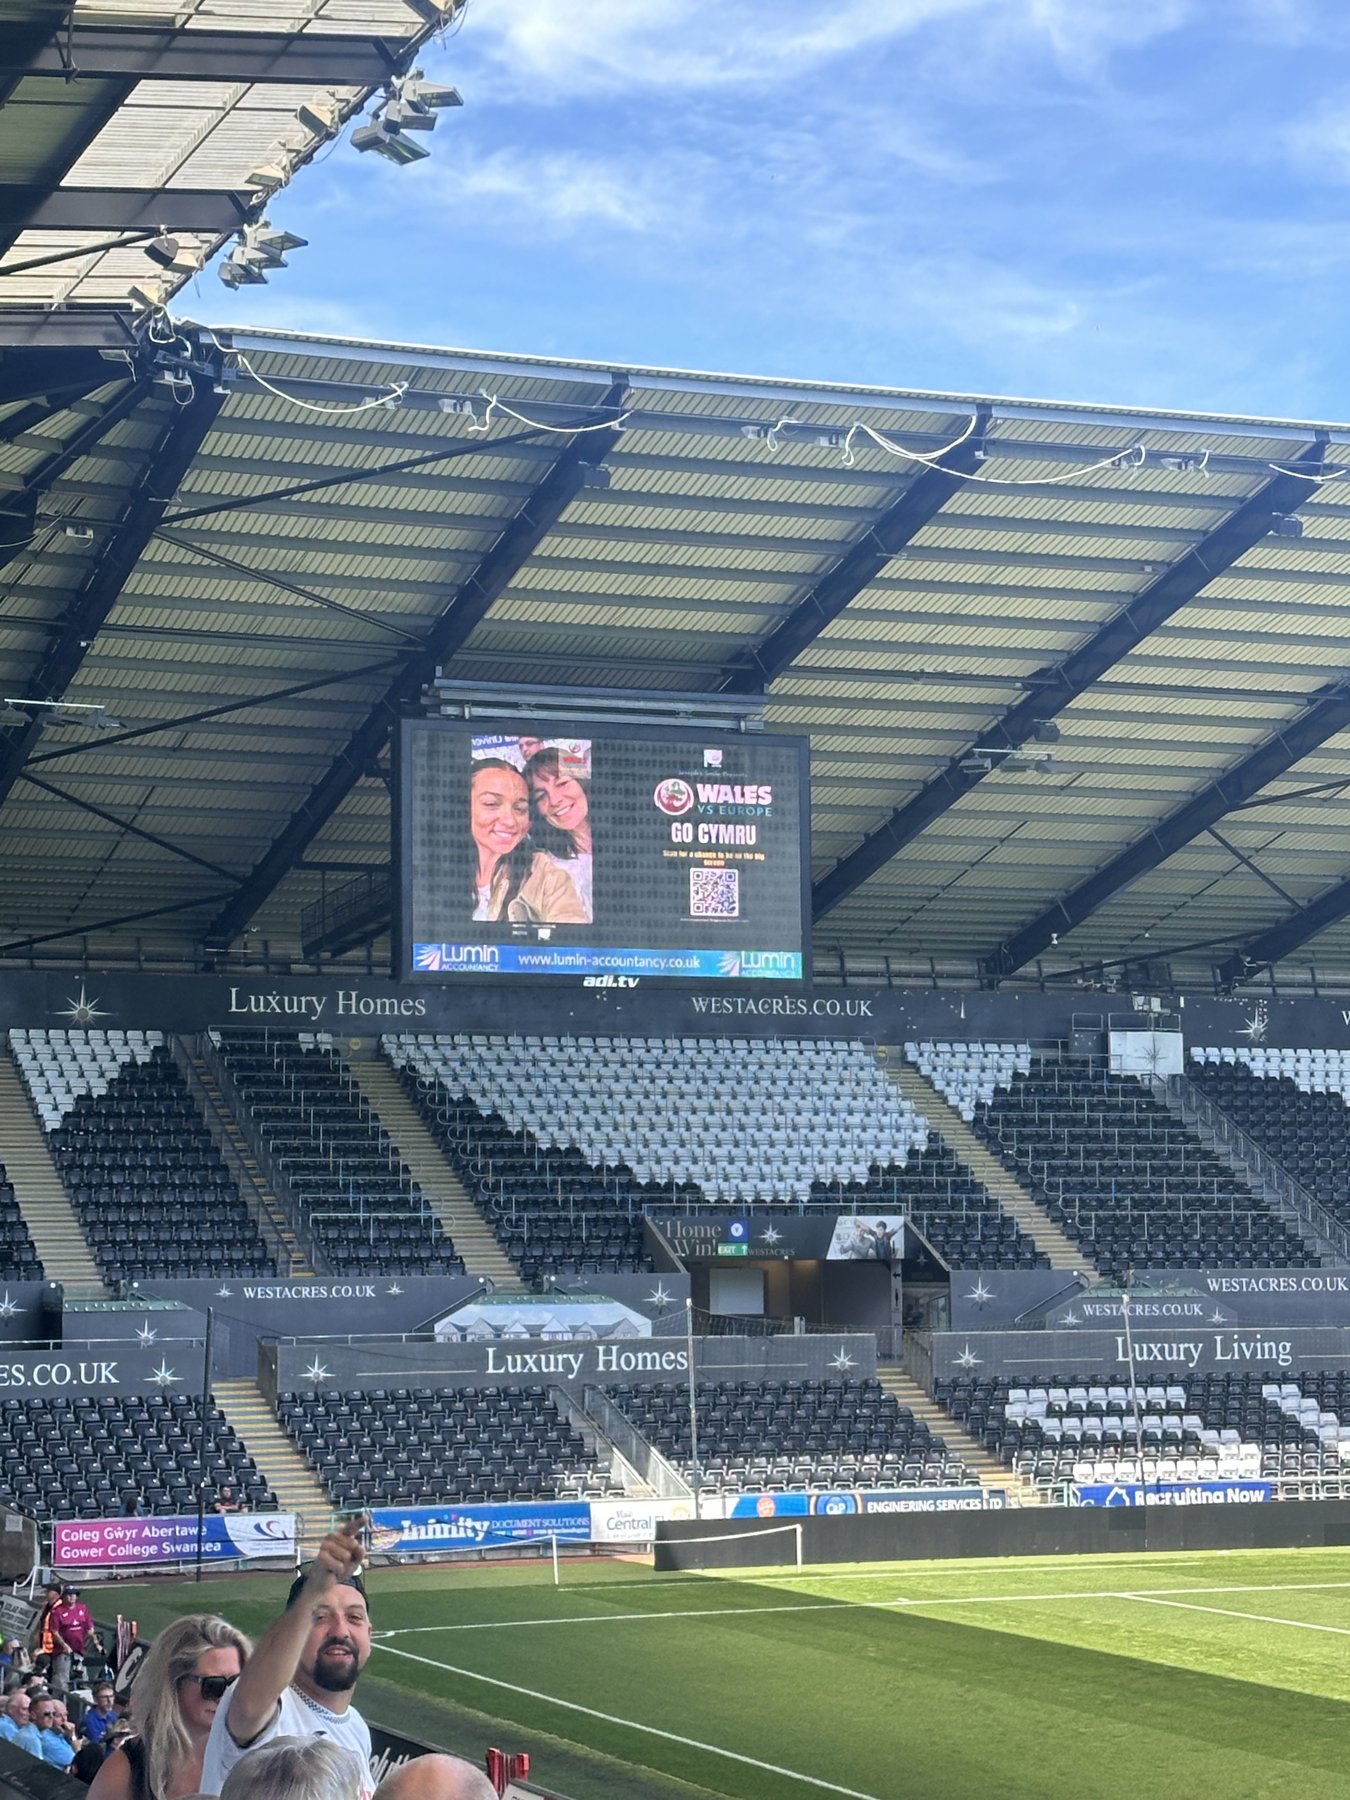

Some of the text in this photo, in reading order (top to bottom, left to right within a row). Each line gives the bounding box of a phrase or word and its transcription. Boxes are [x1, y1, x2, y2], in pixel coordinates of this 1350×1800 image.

[696, 783, 772, 805] WALES
[696, 805, 773, 817] VS EUROPE
[671, 822, 757, 845] GO CYMRU
[442, 943, 499, 962] Lumin
[518, 953, 701, 969] www.lumin-accountancy.co.uk
[741, 950, 795, 969] Lumin
[583, 974, 640, 988] adi.tv
[228, 987, 426, 1021] Luxury Homes
[691, 996, 874, 1017] WESTACRES.CO.UK
[666, 1220, 722, 1238] Home
[717, 1245, 736, 1255] EXIT
[748, 1247, 796, 1256] WESTACRES
[243, 1284, 376, 1299] WESTACRES.CO.UK
[1206, 1277, 1349, 1292] WESTACRES.CO.UK
[1083, 1304, 1203, 1316] WESTACRES.CO.UK
[1115, 1334, 1293, 1367] Luxury Living
[485, 1345, 688, 1379] Luxury Homes
[0, 1362, 120, 1386] ES.CO.UK
[936, 1497, 982, 1511] SERVICES
[1135, 1486, 1265, 1506] Recruiting Now
[491, 1516, 590, 1529] DOCUMENT SOLUTIONS
[606, 1514, 652, 1531] Central
[61, 1524, 207, 1544] Coleg Gŵyr Abertawe
[61, 1539, 222, 1559] Gower College Swansea
